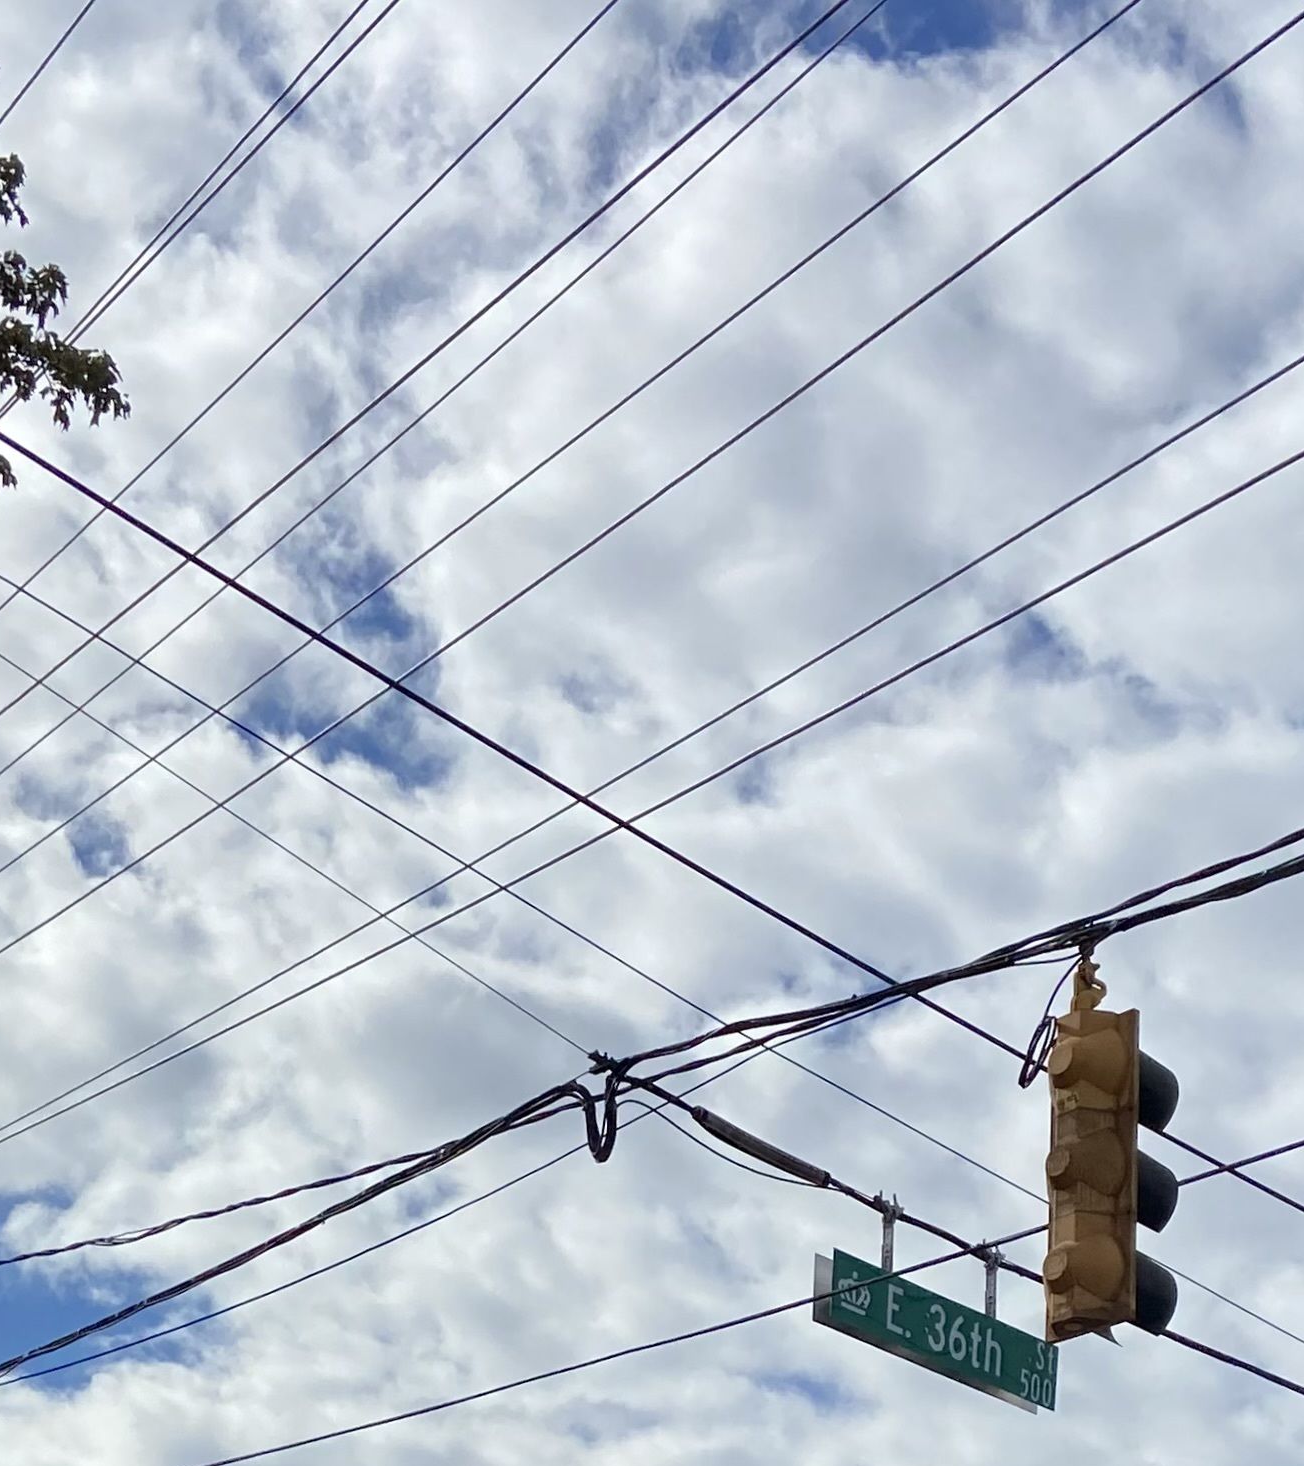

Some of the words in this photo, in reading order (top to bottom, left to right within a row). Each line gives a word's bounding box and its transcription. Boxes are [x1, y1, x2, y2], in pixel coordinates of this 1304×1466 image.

[886, 1283, 911, 1338] E.
[925, 1303, 1003, 1378] 36th
[1035, 1341, 1056, 1376] St
[1019, 1368, 1053, 1408] 500
